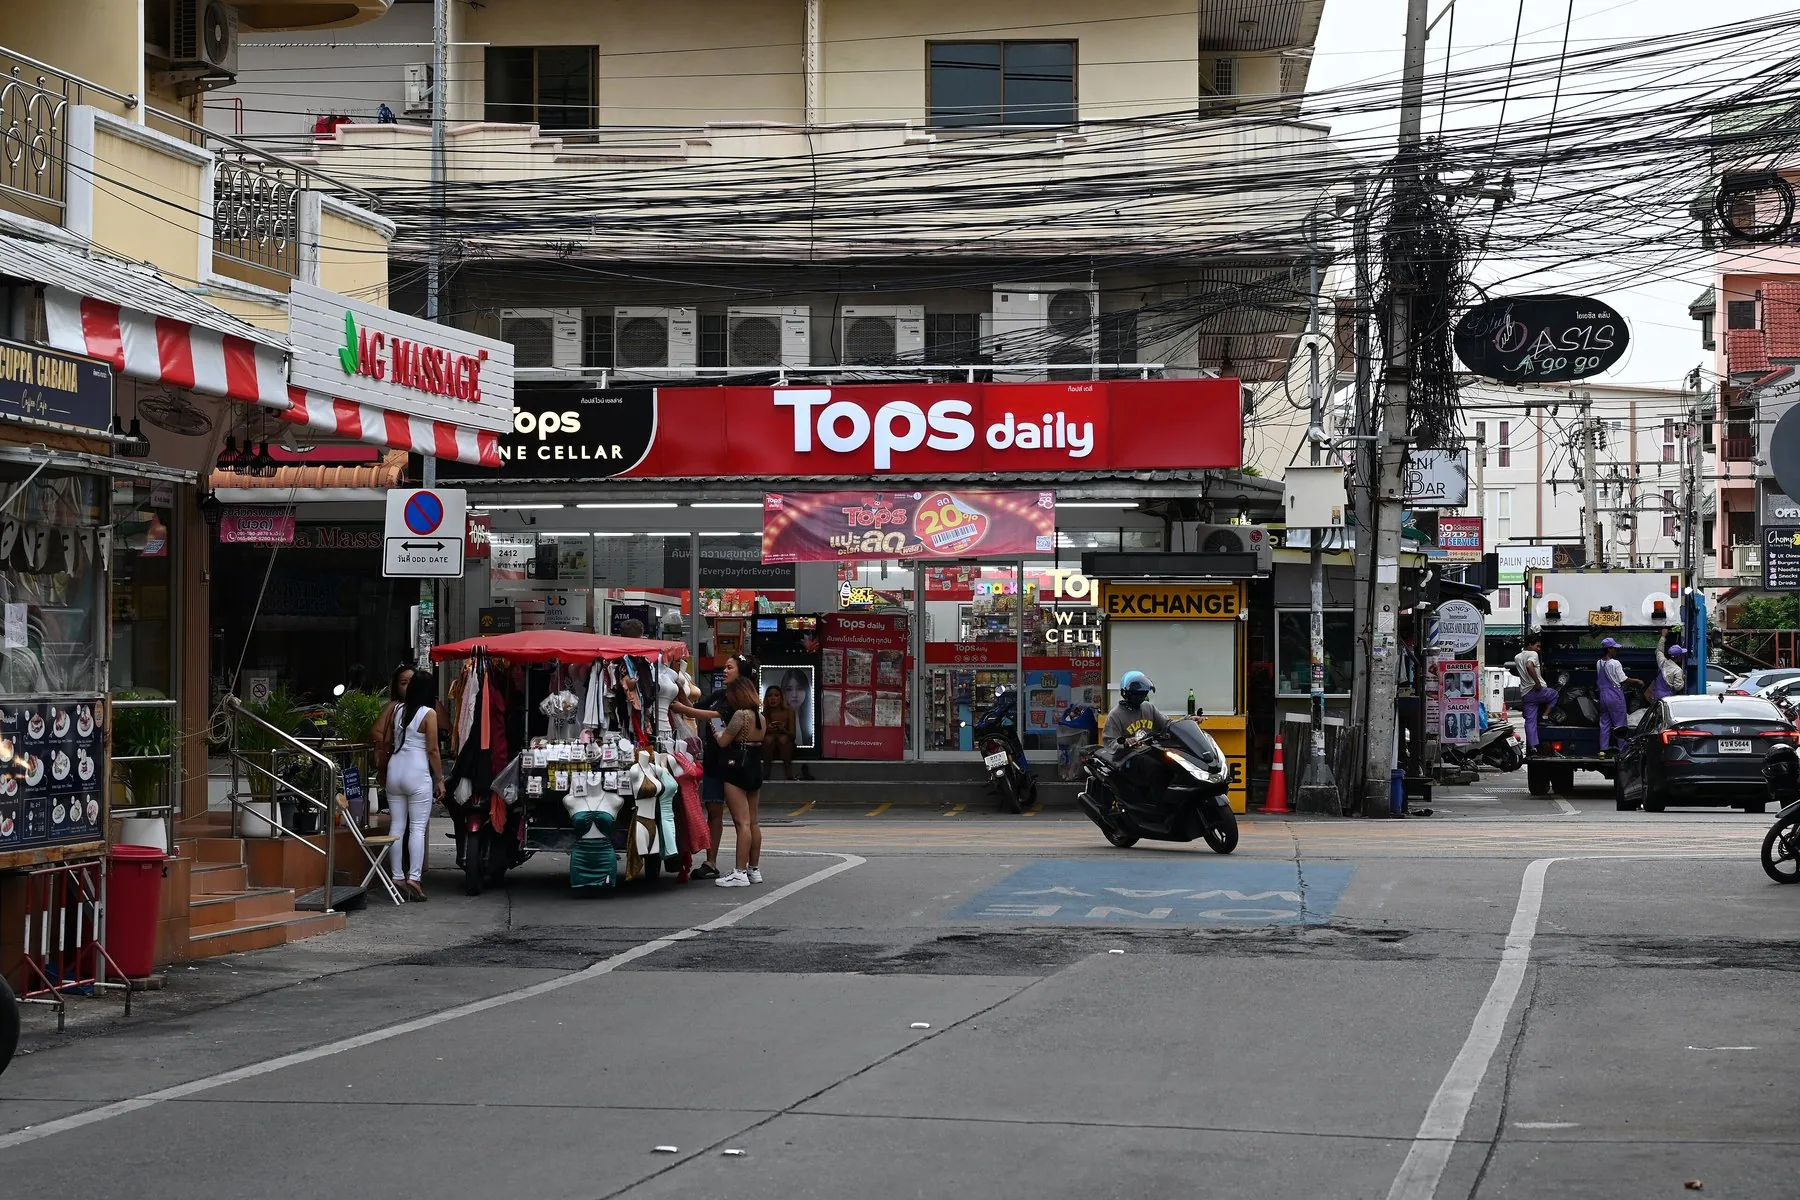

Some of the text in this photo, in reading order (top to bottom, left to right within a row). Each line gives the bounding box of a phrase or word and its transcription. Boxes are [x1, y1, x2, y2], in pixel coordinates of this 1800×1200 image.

[357, 327, 482, 403] AG MASSAGE
[37, 355, 78, 393] CABANA
[774, 389, 1094, 470] Tops daily
[497, 445, 624, 460] NE CELLAR
[937, 497, 950, 506] ลด
[842, 506, 908, 530] Tops
[920, 505, 978, 534] 20%
[1448, 538, 1479, 546] SERVICE
[1768, 530, 1796, 548] Chomp
[1500, 556, 1550, 566] PAILIN HOUSE
[850, 594, 874, 602] SERVE
[852, 588, 872, 596] SOFT
[1108, 594, 1235, 614] EXCHANGE
[837, 618, 886, 630] Tops daily
[1590, 614, 1619, 622] 73-3964
[954, 644, 976, 652] Tops
[1070, 658, 1094, 672] Tops
[1126, 720, 1154, 735] FLOYD
[1011, 886, 1302, 901] WAY
[976, 904, 1299, 919] ONE
